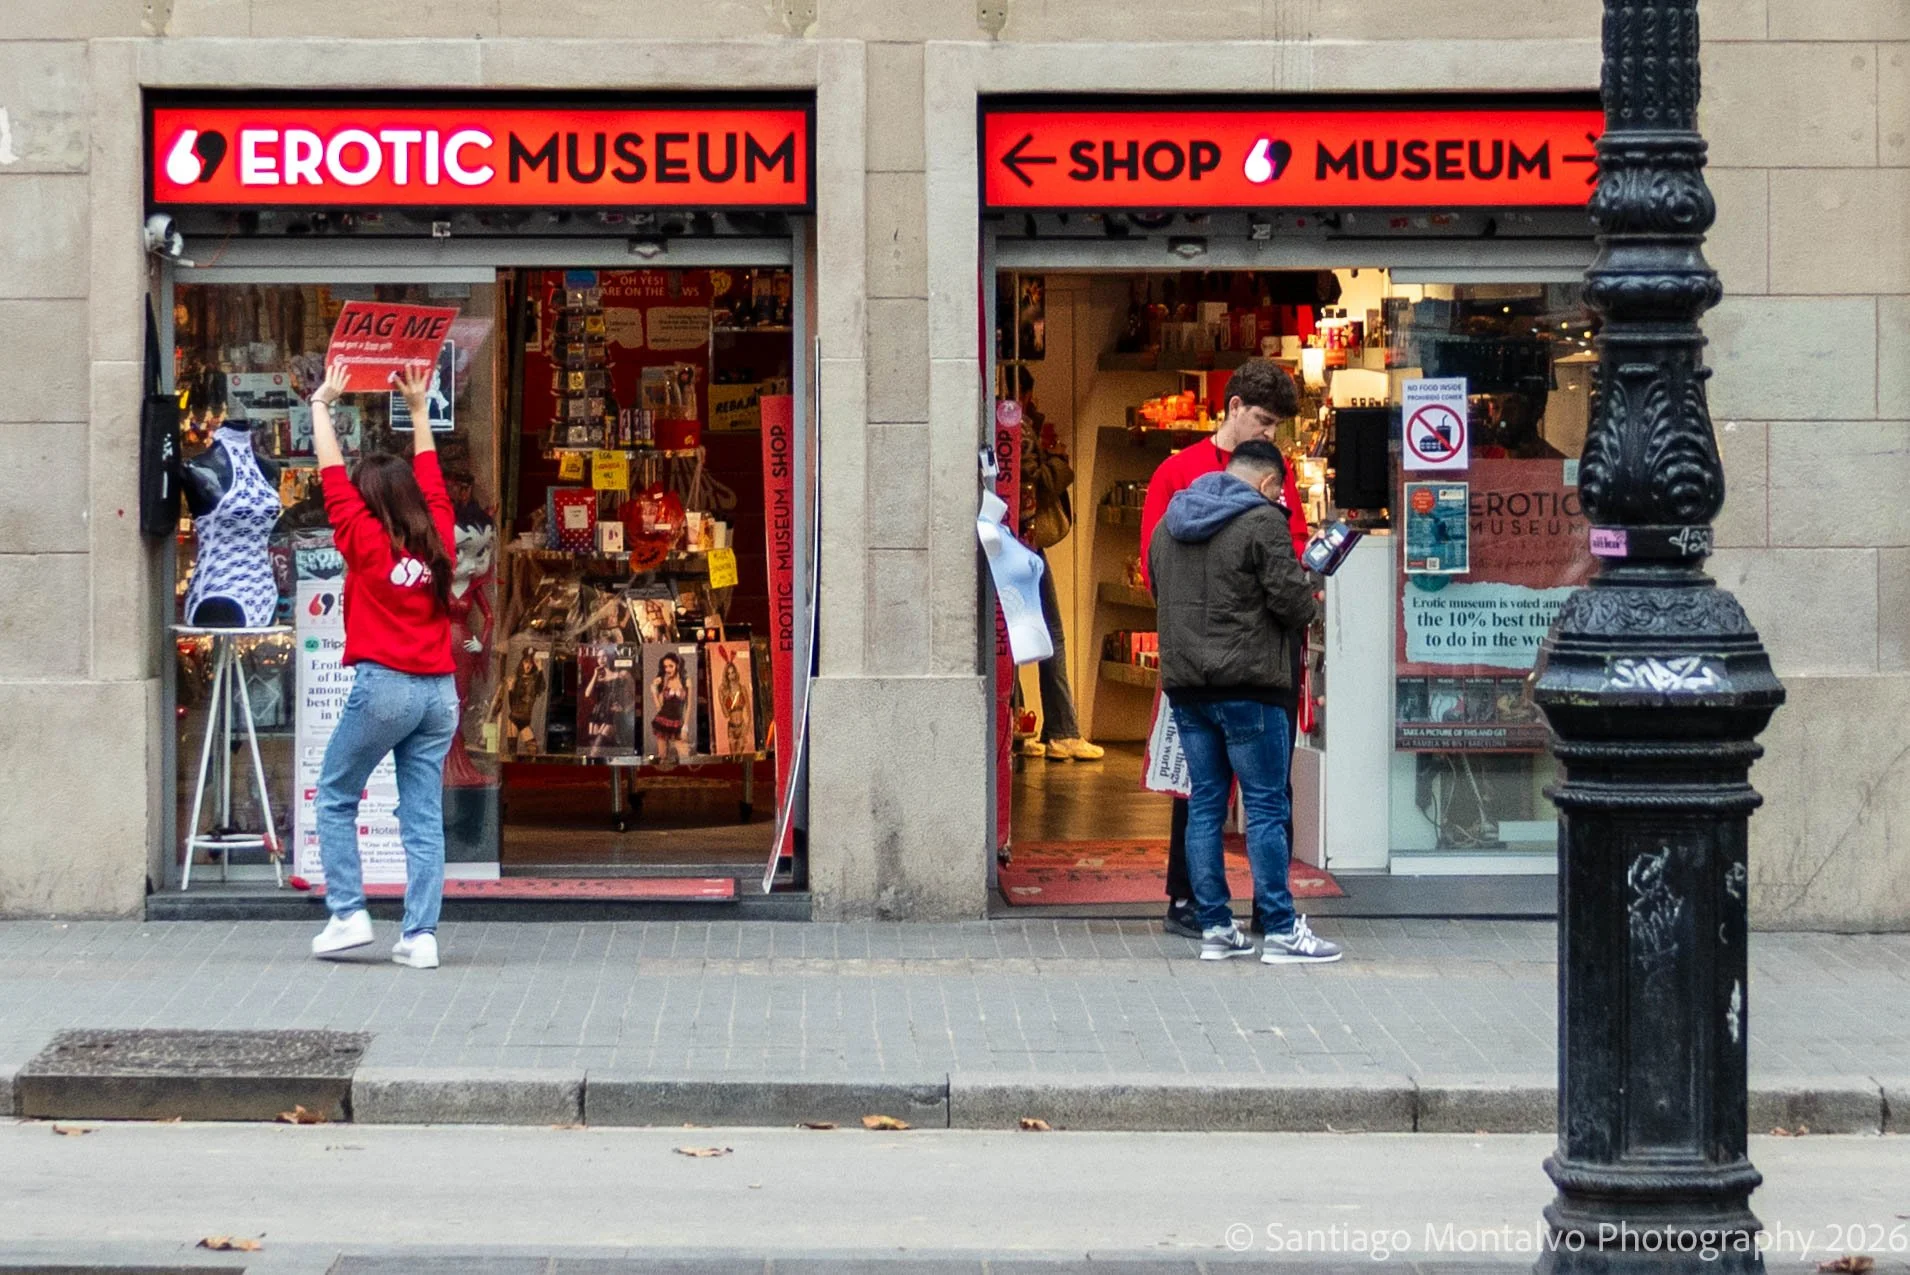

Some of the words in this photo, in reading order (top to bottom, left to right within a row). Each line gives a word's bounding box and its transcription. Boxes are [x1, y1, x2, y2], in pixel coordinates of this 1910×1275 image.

[241, 129, 495, 186] EROTIC
[508, 132, 796, 184] MUSEUM
[1068, 139, 1222, 182] SHOP
[1315, 139, 1551, 181] MUSEUM
[619, 275, 638, 286] OH
[640, 275, 665, 286] YES!
[603, 286, 622, 297] ARE
[625, 286, 641, 297] ON
[645, 286, 665, 297] THE
[341, 311, 397, 337] TAG
[402, 315, 448, 339] ME
[769, 424, 788, 478] SHOP
[997, 429, 1013, 483] SHOP
[1469, 492, 1583, 518] EROTIC
[773, 489, 793, 571] MUSEUM
[1469, 519, 1584, 536] MUSEUM
[1412, 597, 1447, 609] Erotic
[1450, 599, 1497, 609] museum
[1500, 598, 1508, 609] is
[1511, 598, 1541, 609] voted
[777, 583, 793, 652] EROTIC
[1417, 612, 1444, 627] the
[1449, 611, 1486, 627] 10%
[1492, 612, 1524, 627] best
[1425, 633, 1442, 647] to
[1446, 632, 1467, 647] do
[1472, 632, 1487, 647] in
[1493, 632, 1518, 647] the
[1522, 635, 1543, 647] wo
[317, 672, 331, 682] of
[308, 686, 349, 696] among
[306, 697, 331, 708] best
[321, 709, 334, 720] in
[1165, 726, 1177, 743] the
[1159, 745, 1172, 778] world
